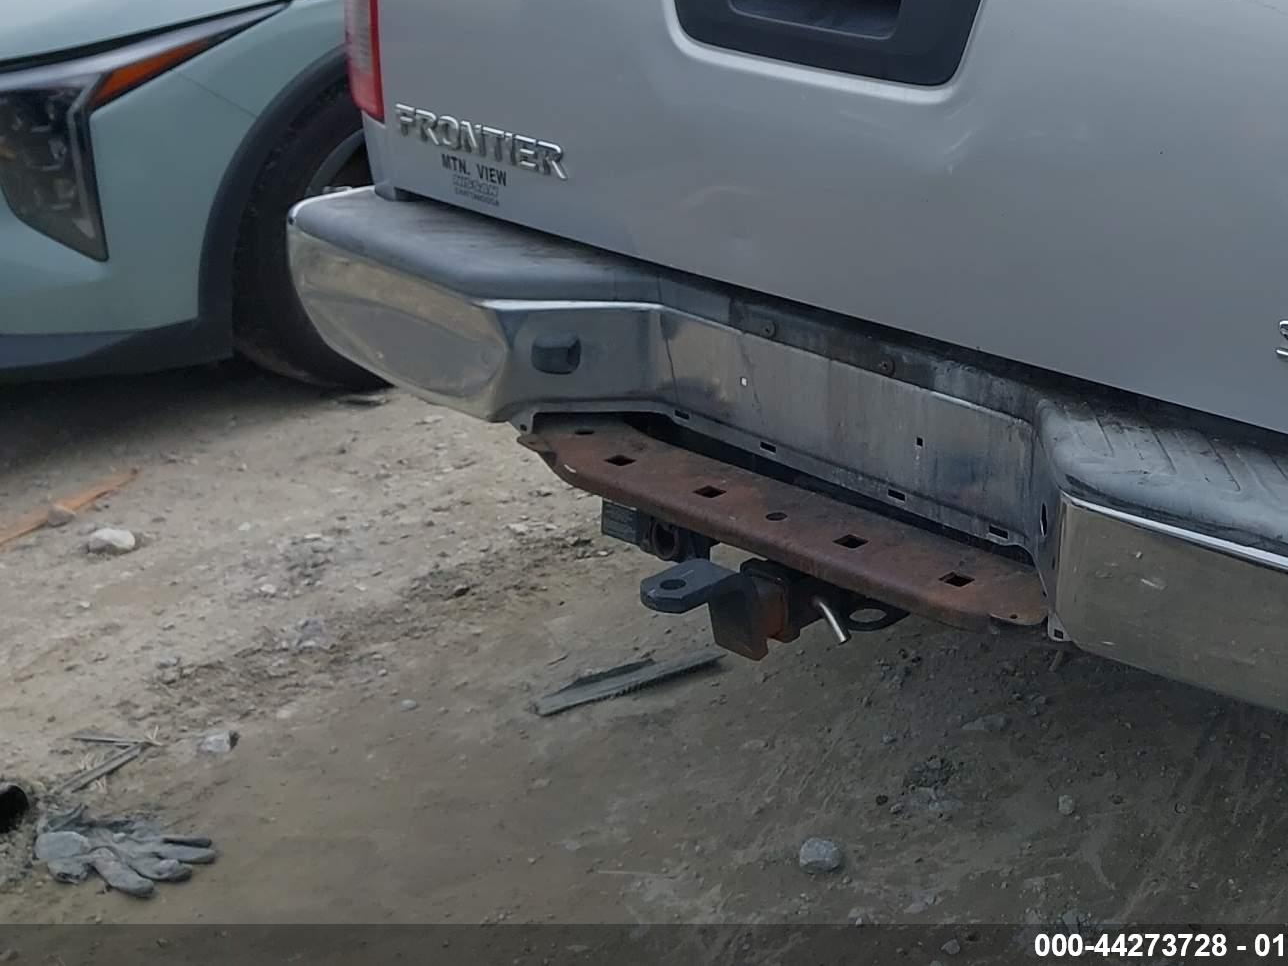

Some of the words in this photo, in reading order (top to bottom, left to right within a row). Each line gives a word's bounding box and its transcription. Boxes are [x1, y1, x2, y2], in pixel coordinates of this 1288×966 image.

[395, 103, 569, 181] FRONTIER
[441, 153, 470, 175] MTN.
[476, 163, 507, 186] VIEW
